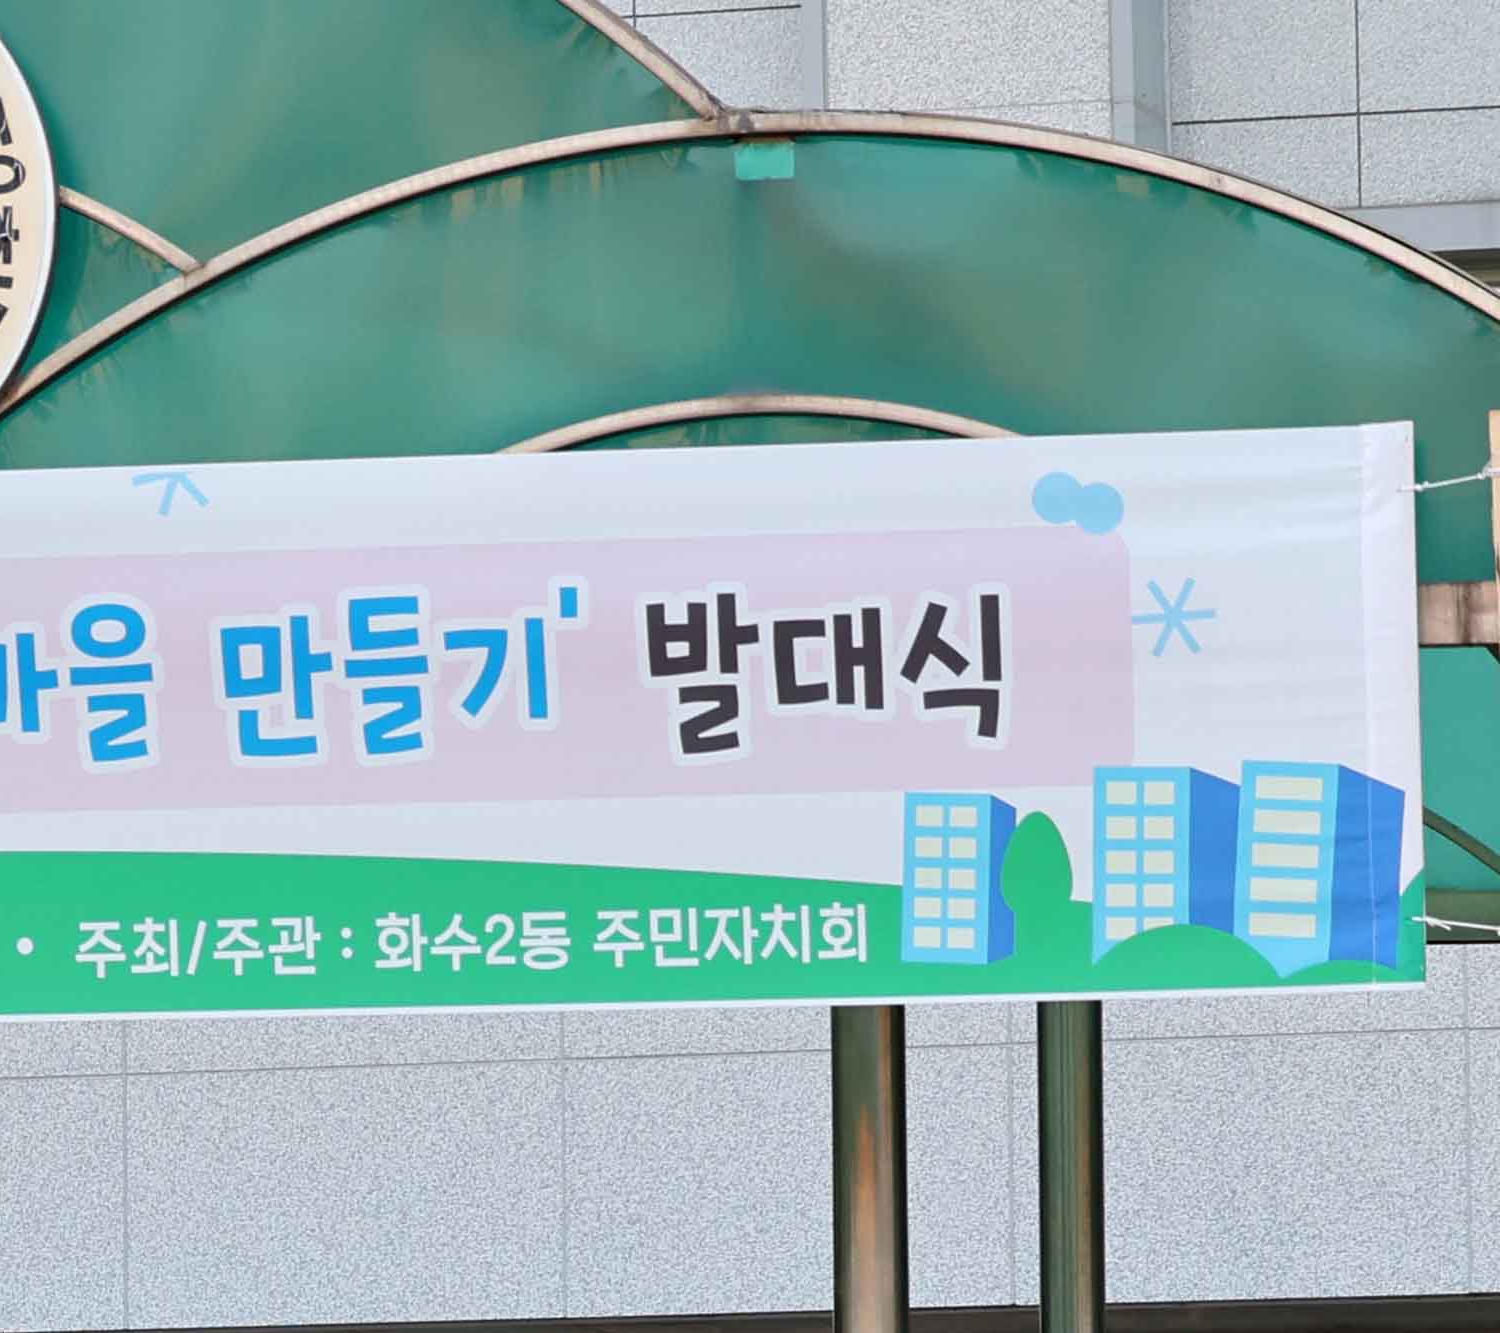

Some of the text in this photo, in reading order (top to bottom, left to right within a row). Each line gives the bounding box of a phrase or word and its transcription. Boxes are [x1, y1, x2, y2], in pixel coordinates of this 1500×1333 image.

[644, 592, 1004, 756] 발대식
[75, 916, 322, 979] 주최/주관
[375, 911, 572, 972] 화수2동
[593, 901, 867, 968] 주민자치회
